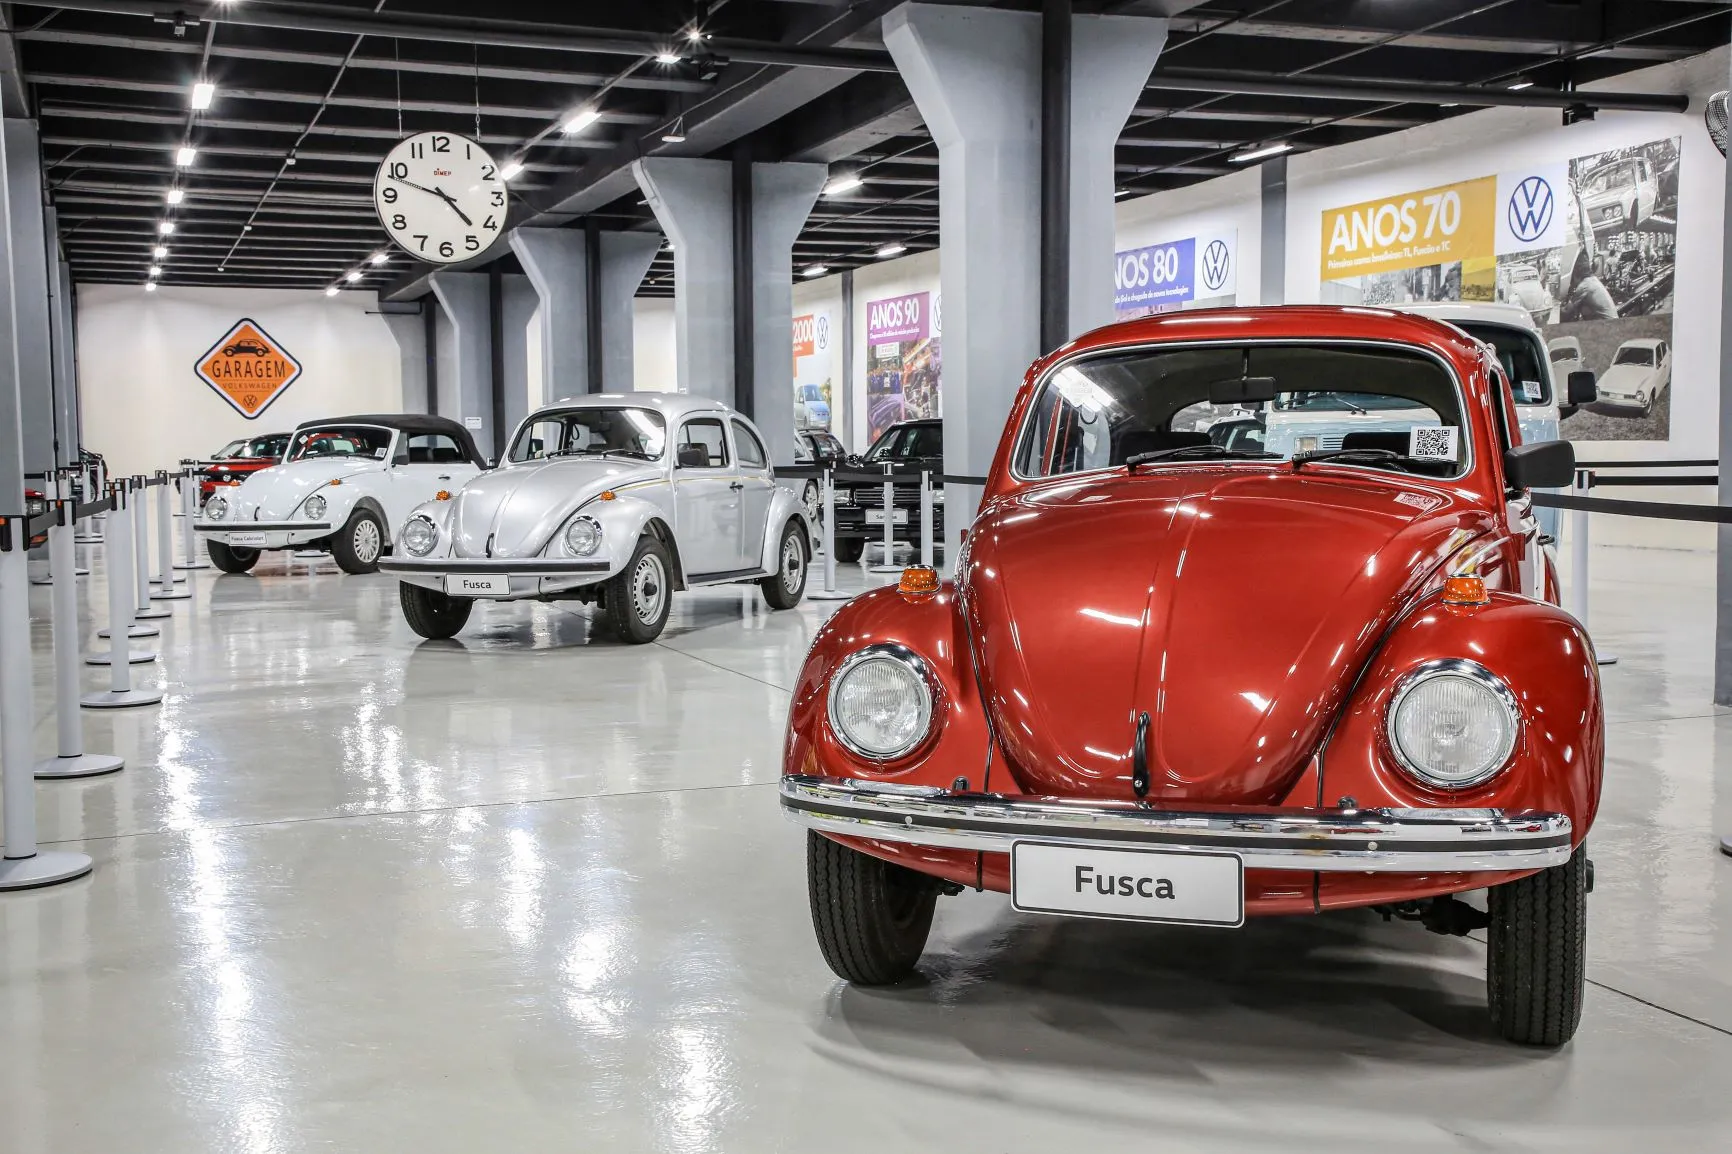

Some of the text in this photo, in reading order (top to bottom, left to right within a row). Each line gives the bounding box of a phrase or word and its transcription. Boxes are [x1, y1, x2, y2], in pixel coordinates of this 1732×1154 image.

[411, 142, 424, 159] 11
[432, 136, 450, 153] 12
[466, 143, 471, 160] 1
[388, 162, 408, 179] 10
[481, 165, 495, 181] 2
[382, 187, 398, 204] 9
[491, 191, 505, 208] 3
[392, 214, 407, 230] 8
[483, 215, 498, 231] 4
[1328, 190, 1461, 255] ANOS 70
[413, 235, 428, 252] 7
[439, 242, 455, 258] 6
[465, 235, 480, 251] 5
[1152, 246, 1179, 284] 80
[870, 297, 919, 330] ANOS 90
[211, 360, 286, 379] GARAGEM
[463, 579, 492, 589] Fusca
[1074, 865, 1176, 900] Fusca
